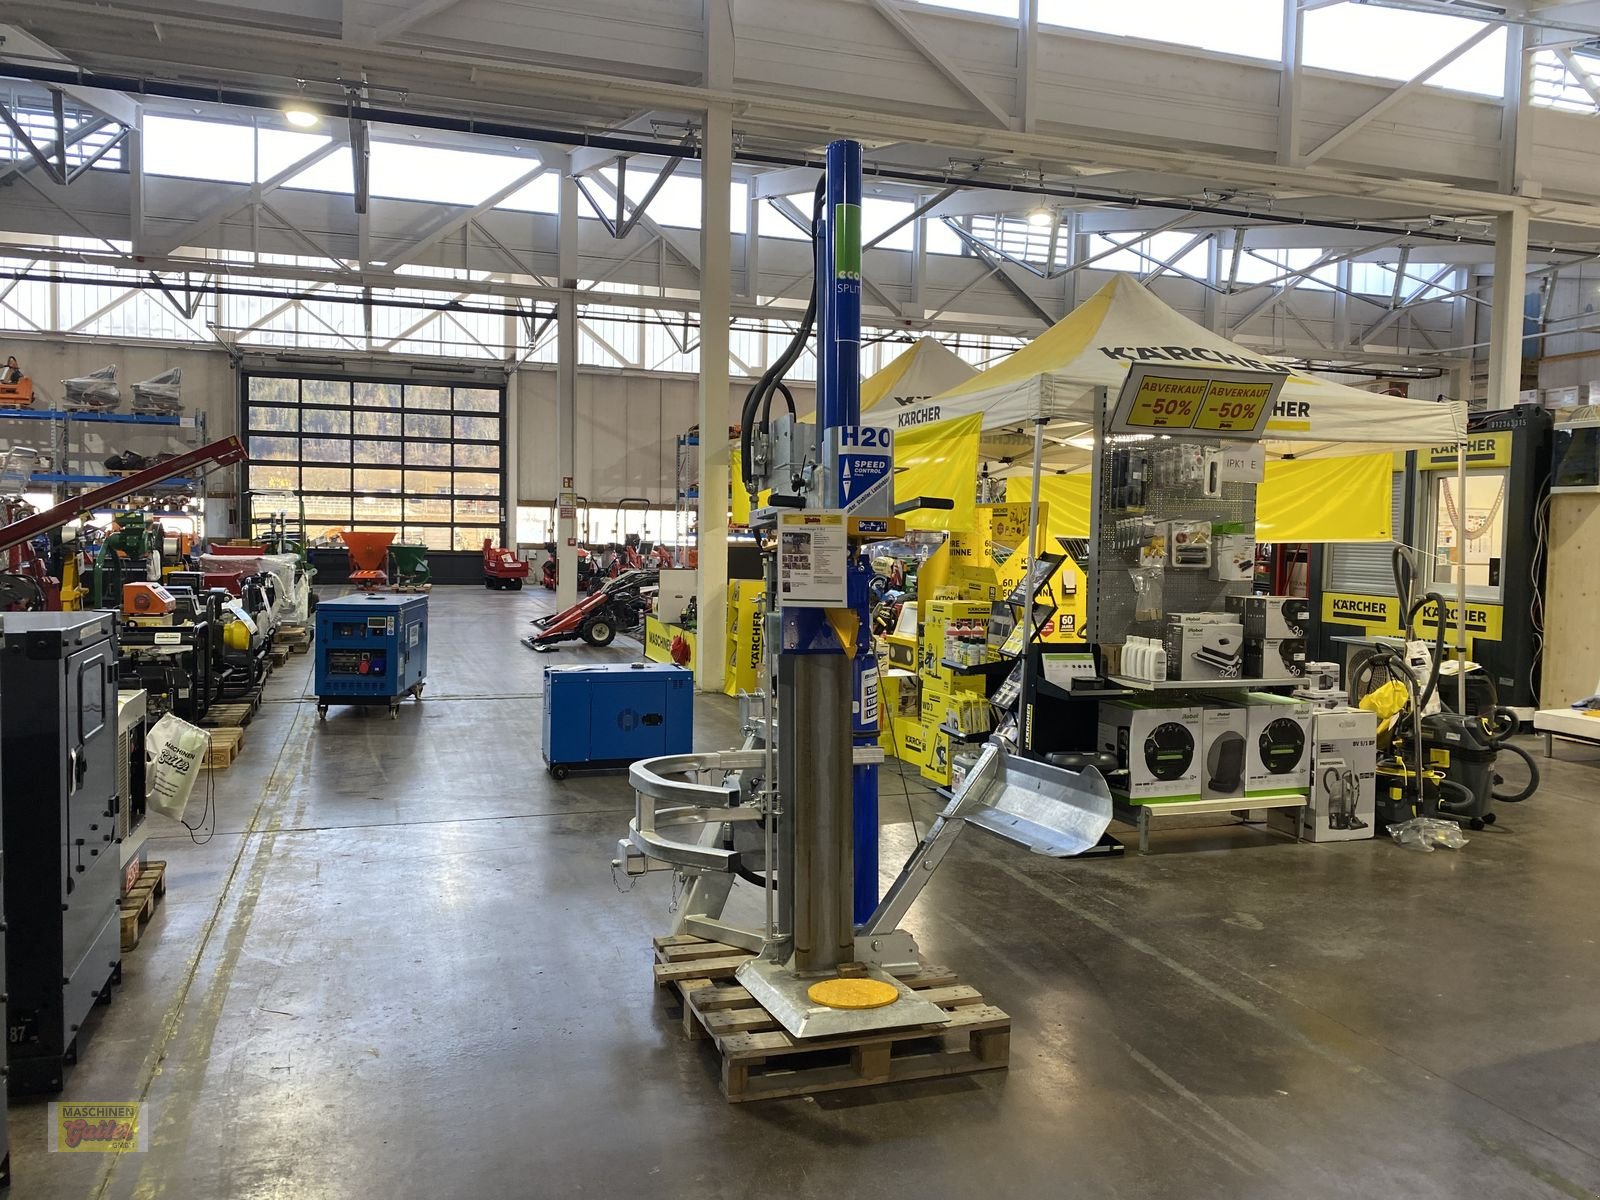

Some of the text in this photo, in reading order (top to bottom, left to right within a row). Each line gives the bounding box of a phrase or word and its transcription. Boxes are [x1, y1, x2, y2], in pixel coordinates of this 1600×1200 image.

[1141, 382, 1206, 395] ABVERKAUF
[1209, 386, 1270, 398] ABVERKAUF
[1272, 400, 1311, 418] HER
[898, 405, 941, 428] KÄRCHER
[841, 426, 890, 448] H20
[854, 460, 886, 469] SPEED
[1002, 579, 1013, 587] 60
[1333, 599, 1386, 614] KÄRCHER
[1061, 615, 1073, 625] 60
[751, 611, 761, 669] KÄRCHER
